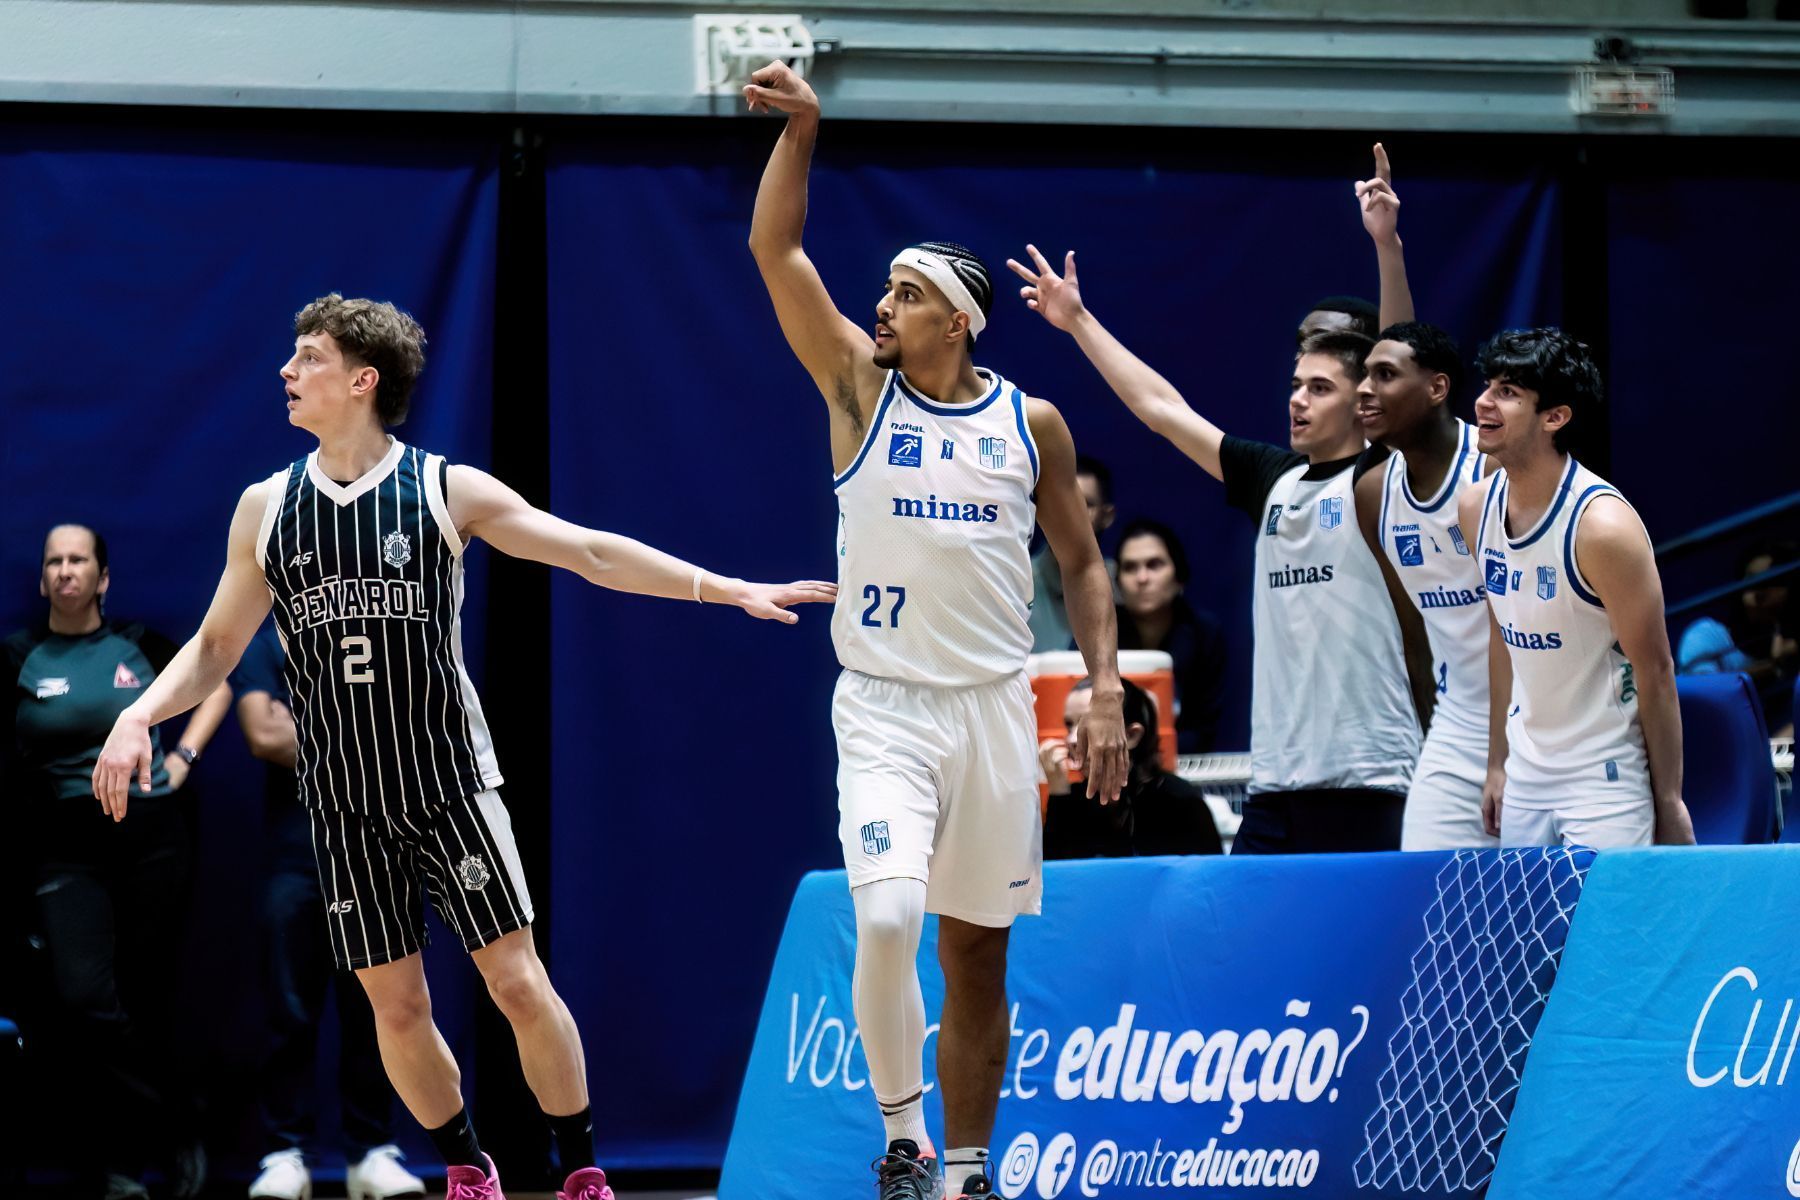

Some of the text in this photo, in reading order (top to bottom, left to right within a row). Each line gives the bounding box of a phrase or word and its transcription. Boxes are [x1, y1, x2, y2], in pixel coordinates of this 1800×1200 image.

[892, 494, 998, 523] minas
[1269, 564, 1334, 589] minas
[1418, 585, 1486, 608] minas
[290, 574, 429, 634] PEÑAROL
[862, 584, 906, 628] 27
[340, 636, 375, 683] 2
[787, 992, 878, 1091] Voc
[1054, 999, 1370, 1135] educação?
[1080, 1137, 1320, 1198] @mtceducacao
